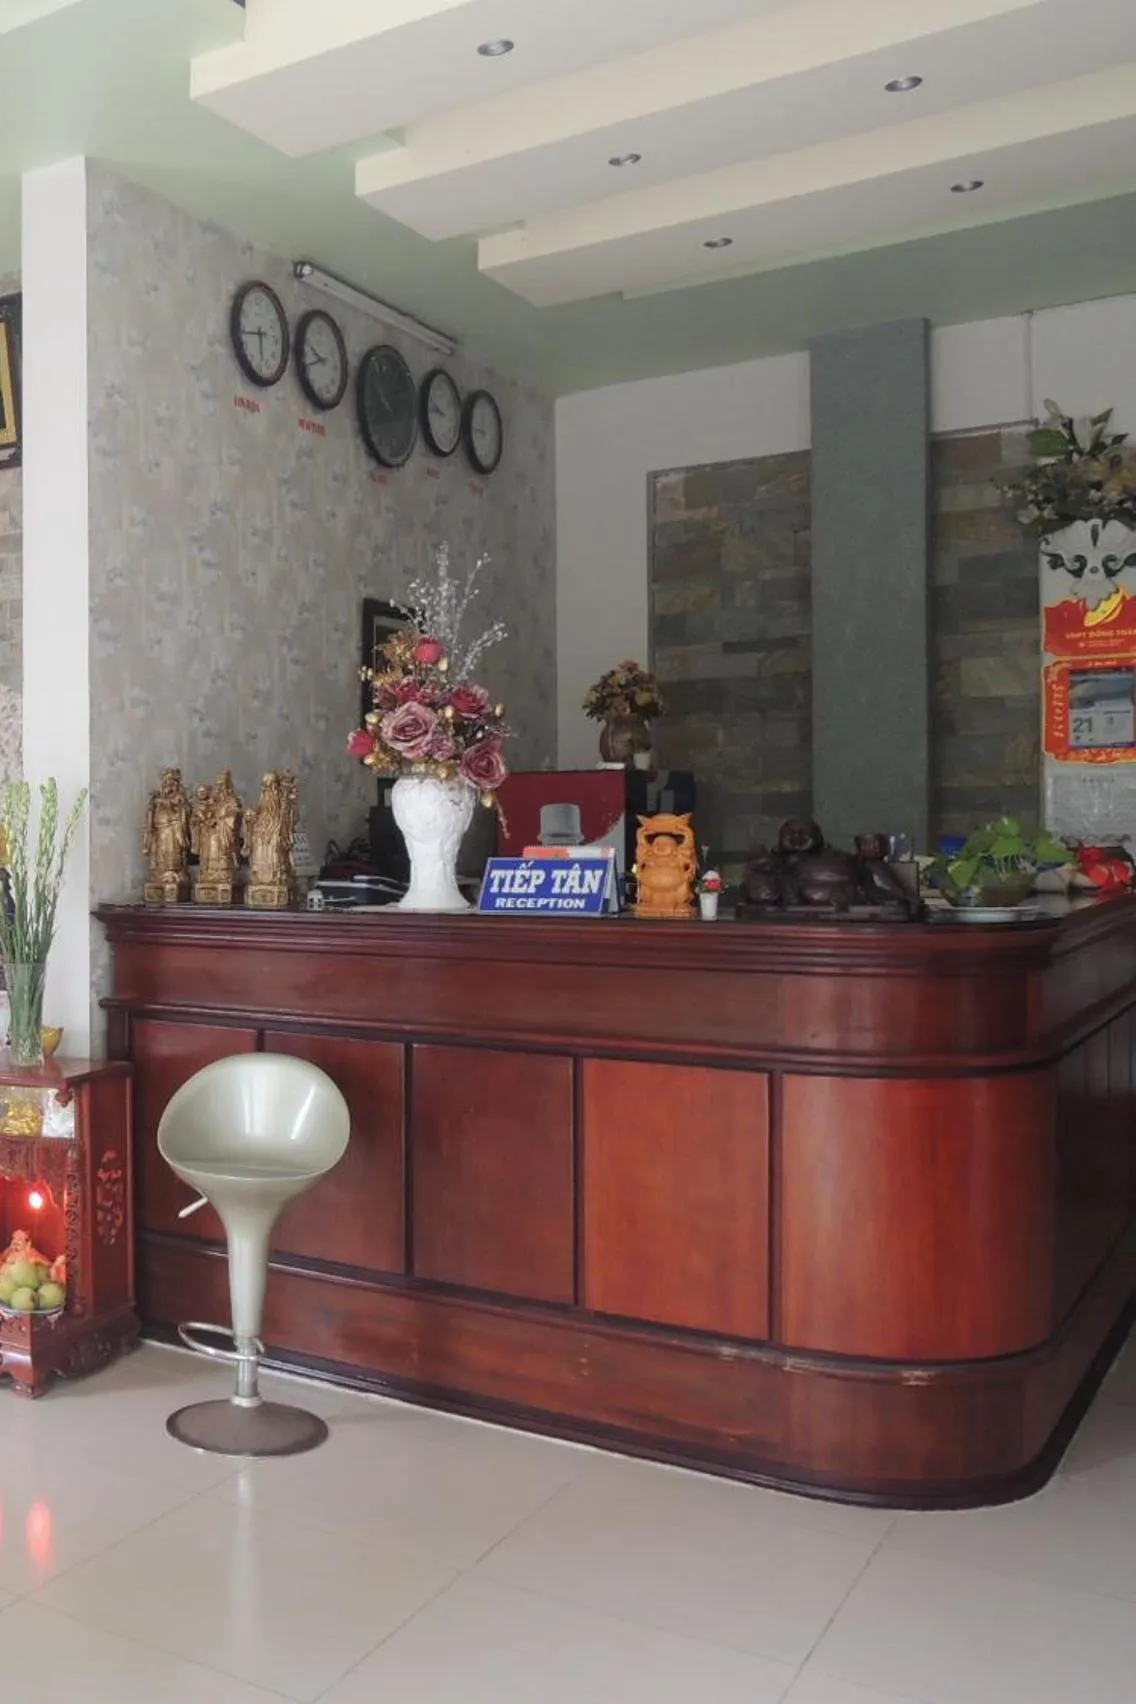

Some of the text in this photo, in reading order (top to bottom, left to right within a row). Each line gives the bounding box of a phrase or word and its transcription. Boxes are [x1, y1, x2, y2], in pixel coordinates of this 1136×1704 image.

[1072, 716, 1093, 733] 21
[489, 861, 604, 894] TIẾP TÂN
[495, 897, 586, 909] RECEPTION
